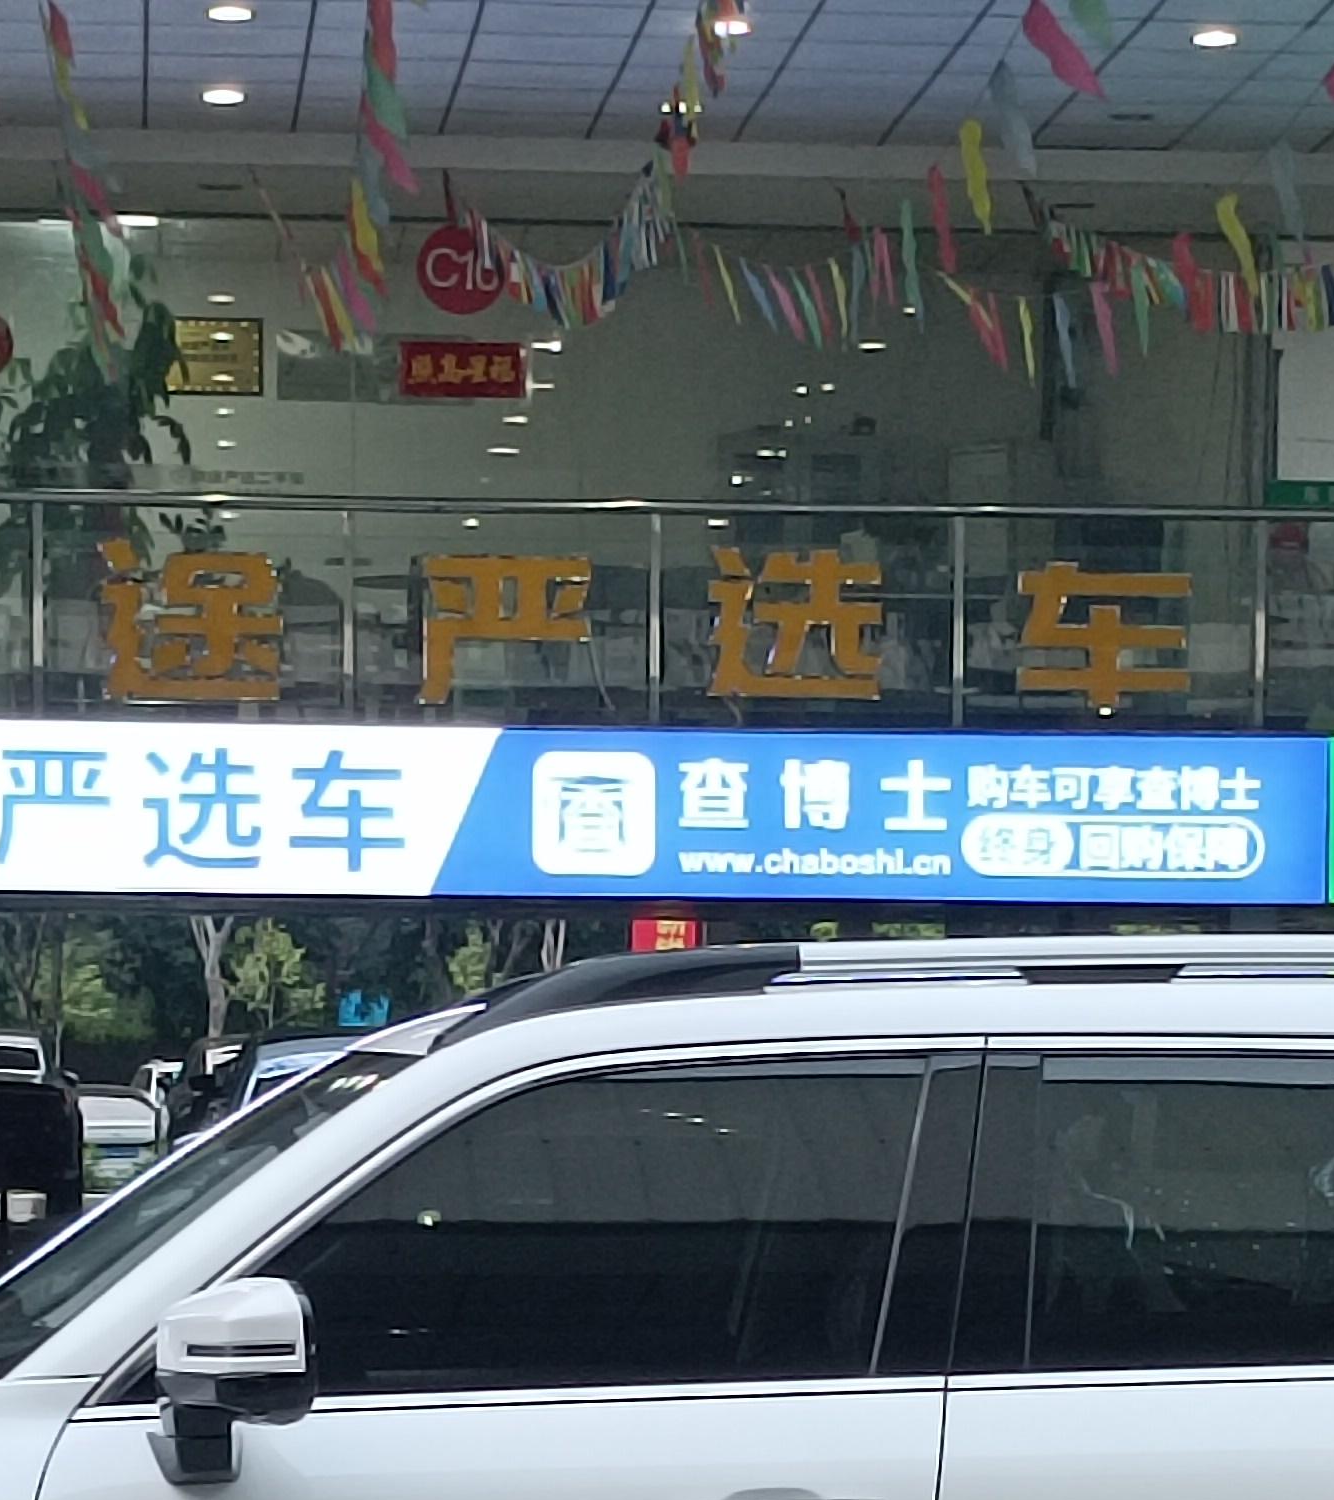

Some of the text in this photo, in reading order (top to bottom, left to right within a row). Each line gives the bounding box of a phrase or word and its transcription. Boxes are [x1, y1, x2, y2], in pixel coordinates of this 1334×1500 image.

[678, 757, 953, 831] 查博士
[967, 763, 1262, 811] 购车可享查博士
[678, 847, 953, 876] www.chaboshi.cn
